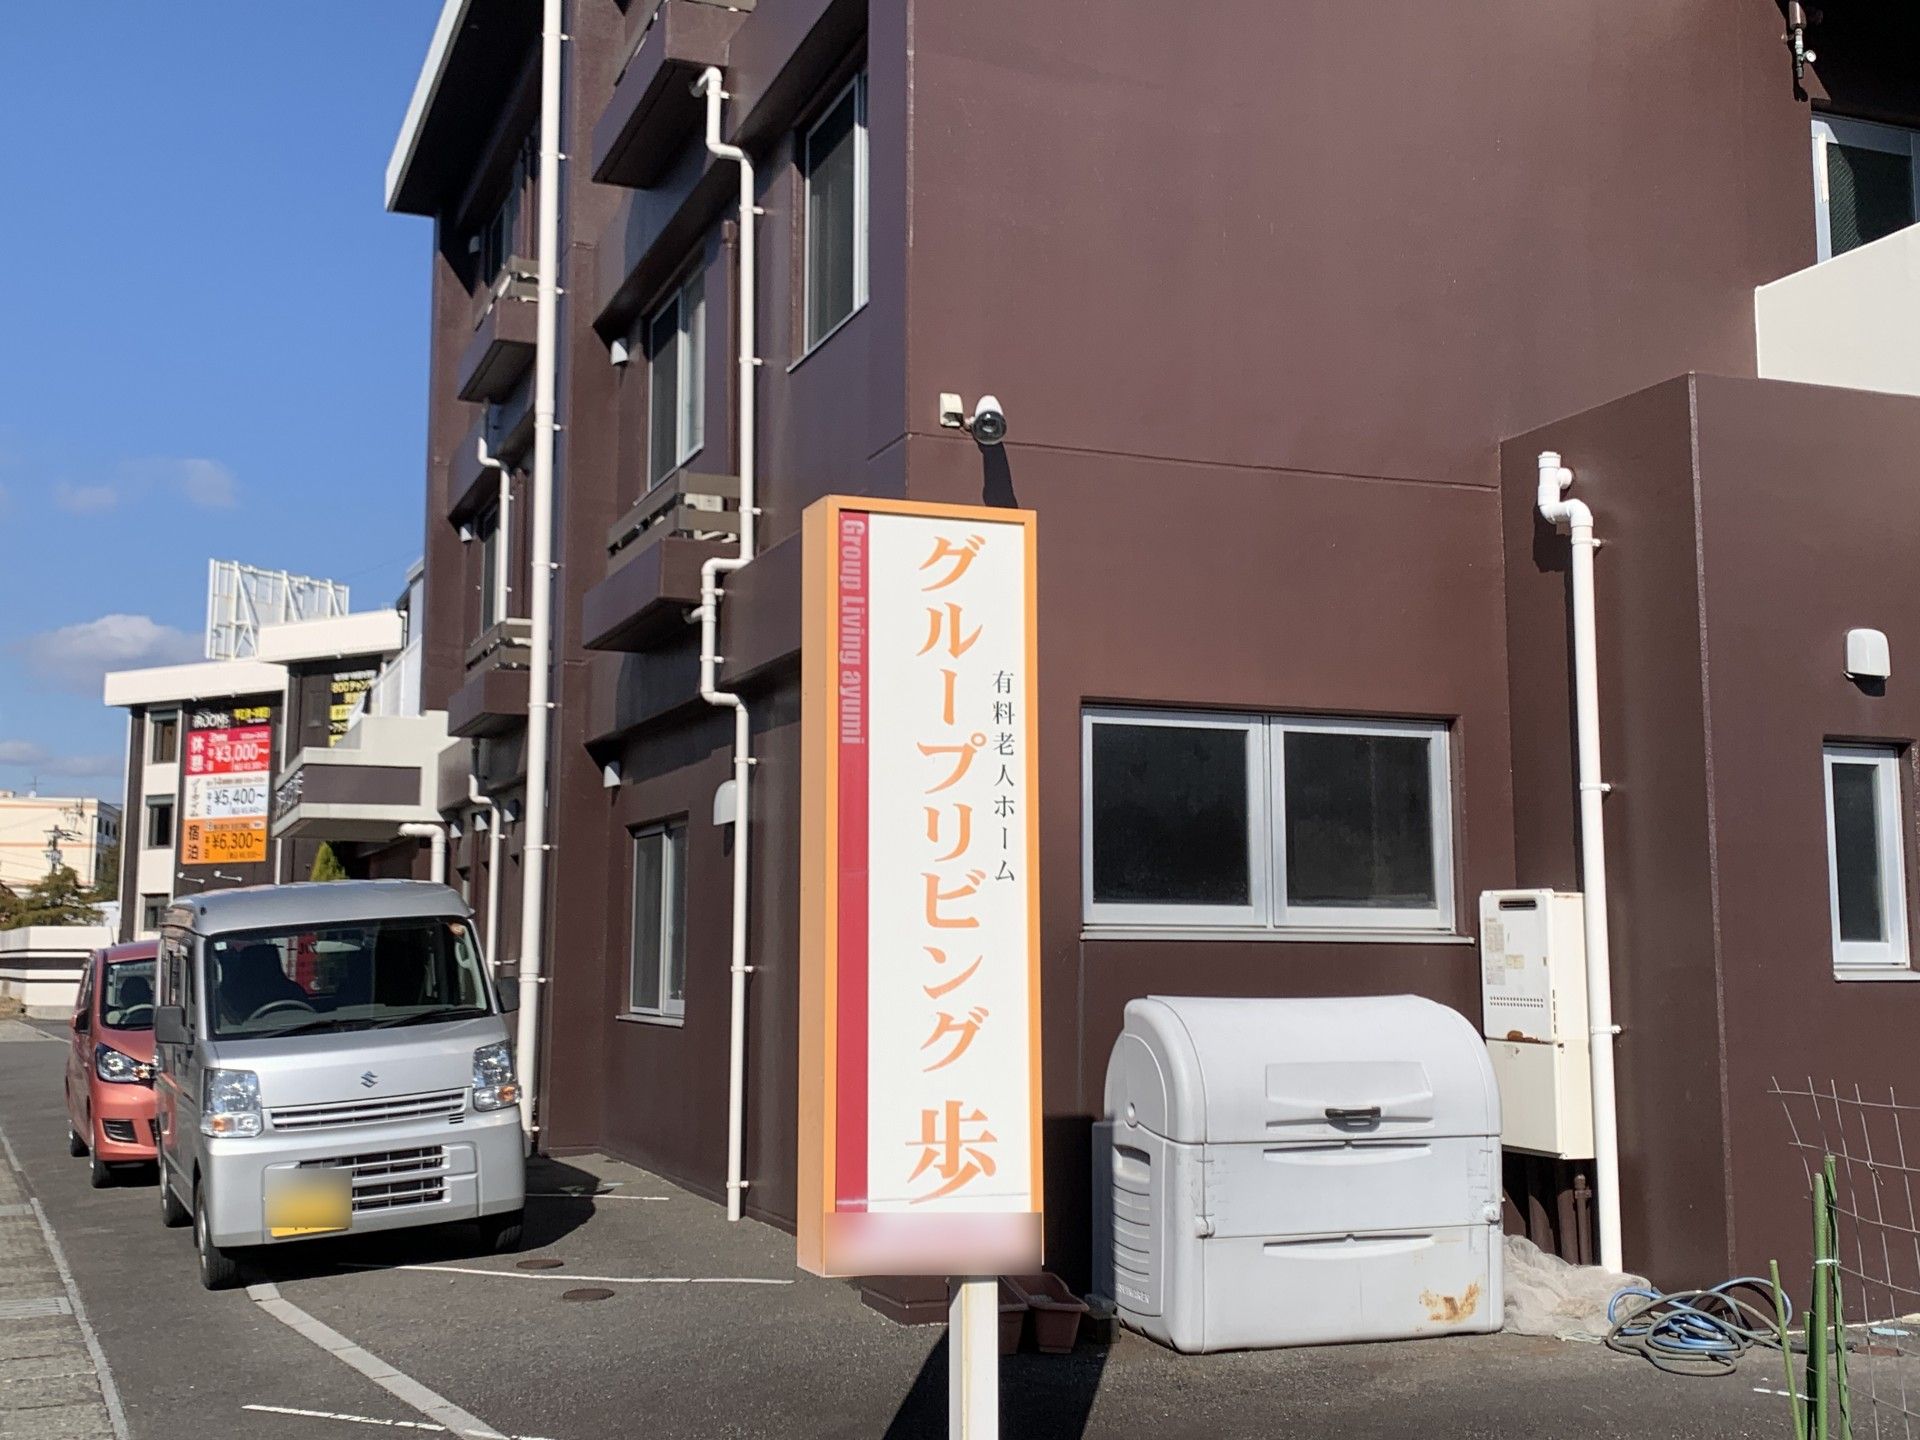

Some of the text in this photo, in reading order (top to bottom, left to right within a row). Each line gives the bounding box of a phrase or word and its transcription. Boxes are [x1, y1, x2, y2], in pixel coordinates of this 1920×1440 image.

[840, 519, 865, 744] Group Living ayumi
[993, 670, 1015, 881] 有料老人ホーム
